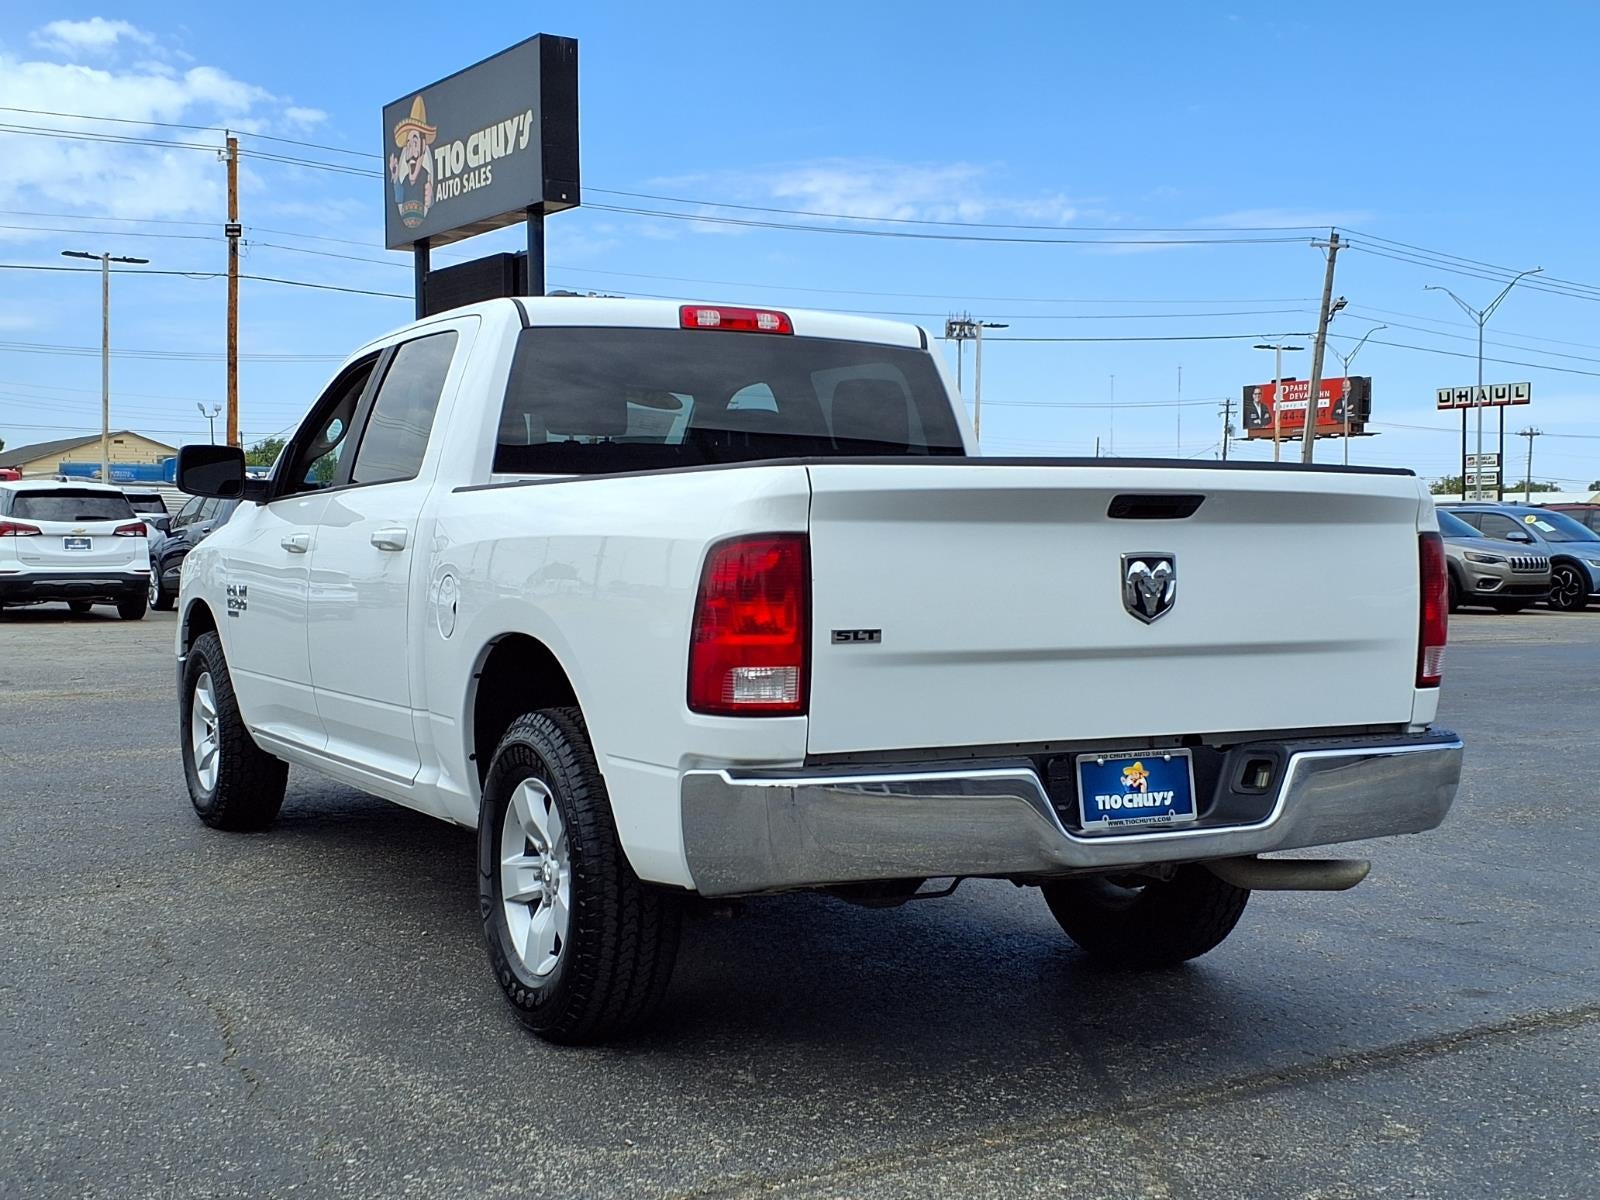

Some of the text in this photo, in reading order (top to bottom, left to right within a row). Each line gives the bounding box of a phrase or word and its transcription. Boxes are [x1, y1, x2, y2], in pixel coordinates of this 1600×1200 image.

[434, 109, 534, 181] TIO CHUY'S
[435, 165, 493, 203] AUTO SALES
[834, 630, 879, 642] SLT
[1095, 790, 1174, 810] TIO CHUY'S
